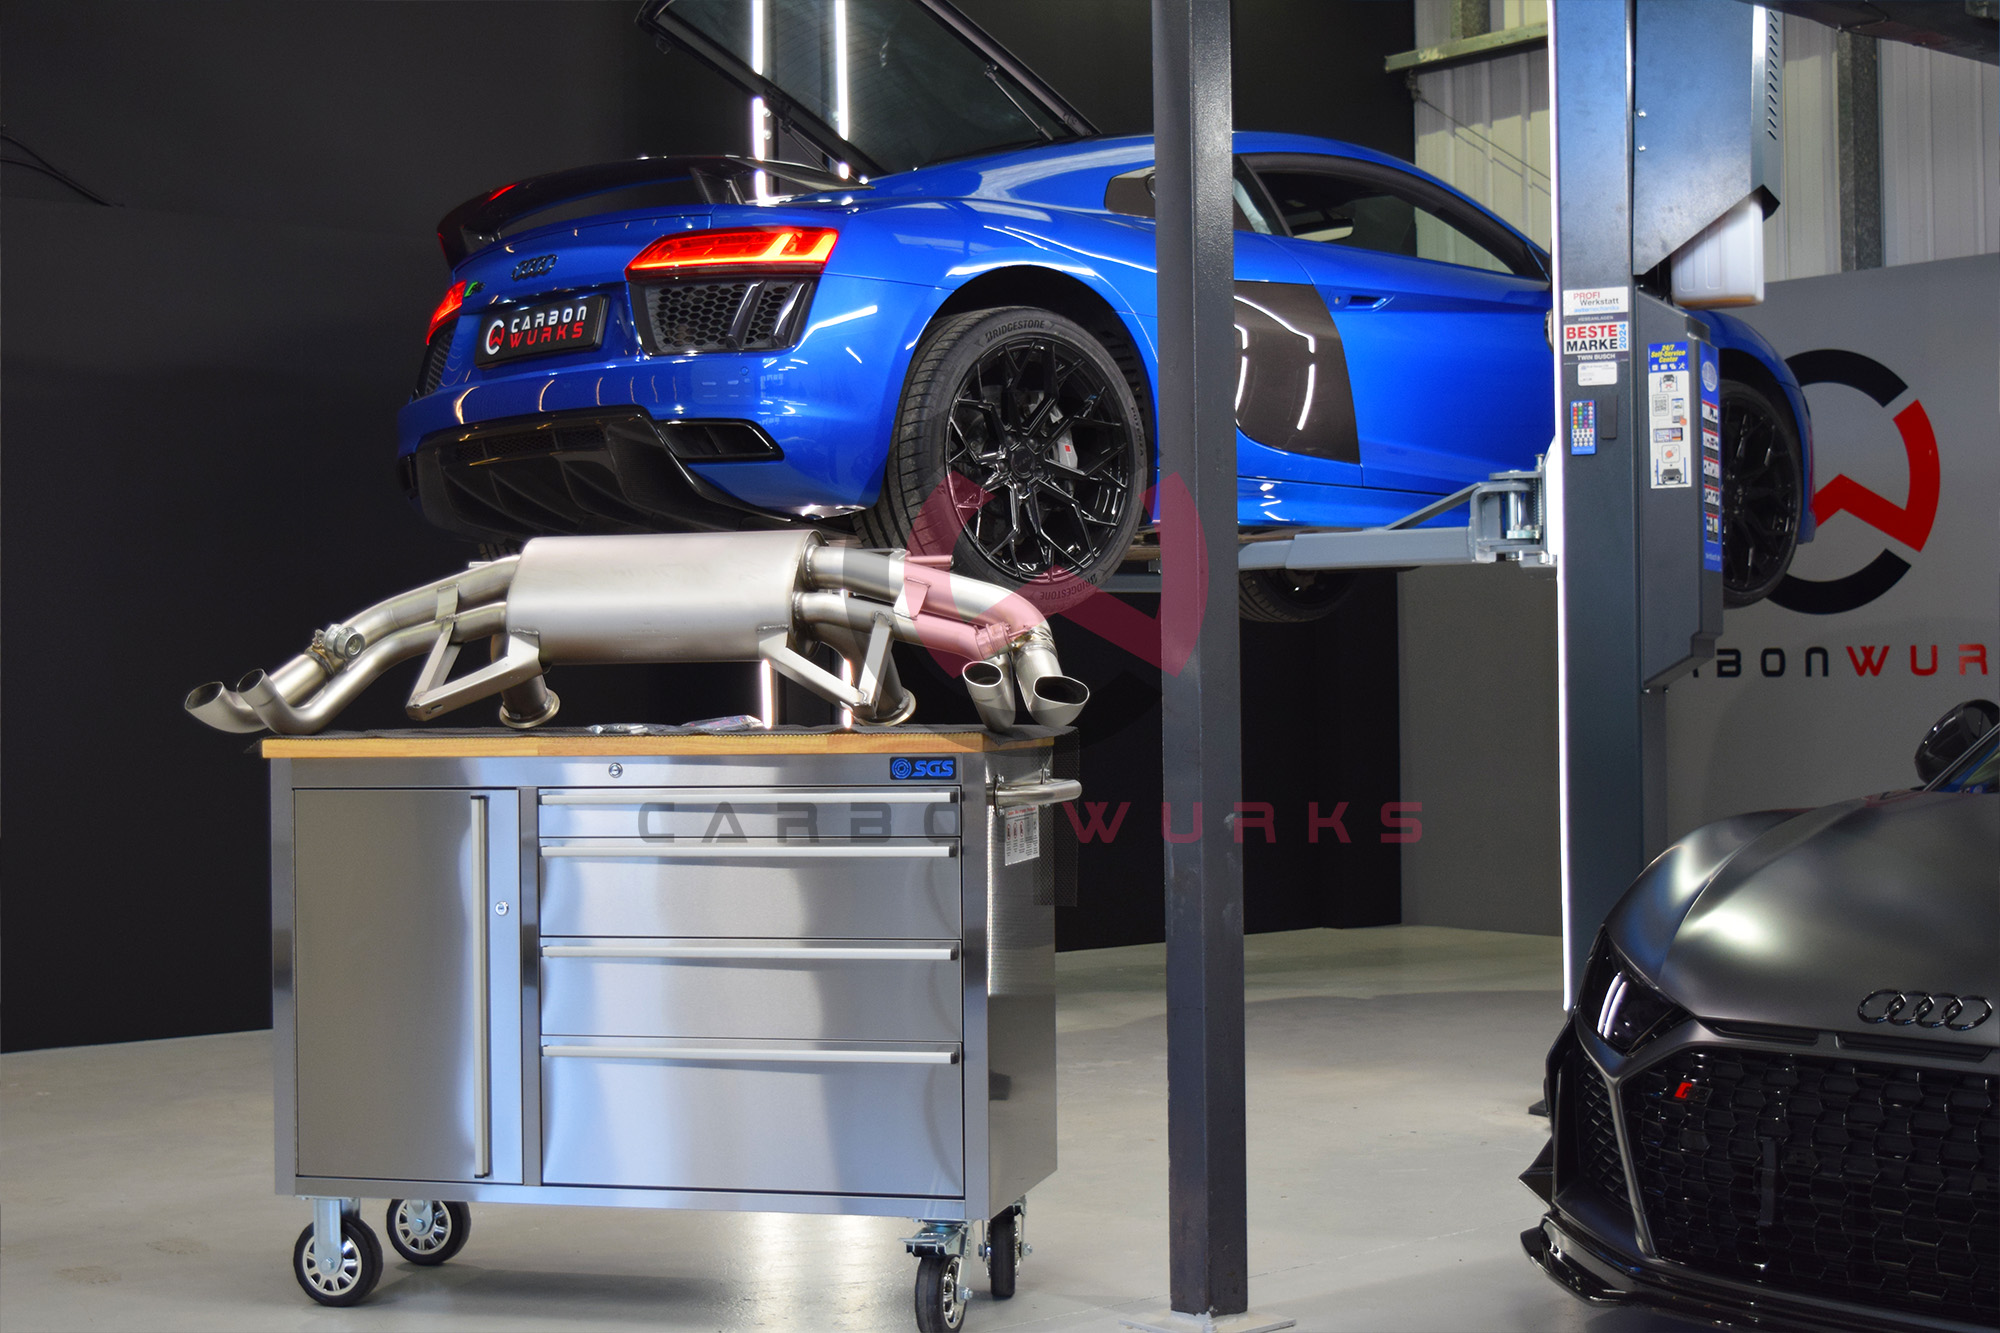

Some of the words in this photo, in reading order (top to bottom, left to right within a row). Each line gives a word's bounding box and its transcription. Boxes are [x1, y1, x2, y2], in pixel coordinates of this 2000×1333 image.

[1574, 292, 1600, 300] PROFI
[1579, 298, 1619, 306] Werkstatt
[511, 306, 587, 334] CARBON
[510, 321, 584, 349] WURKS
[984, 319, 1045, 343] BRIDGESTONE
[1566, 324, 1618, 340] BESTE
[1619, 323, 1627, 349] 2024
[1566, 338, 1618, 353] MARKE
[1651, 350, 1686, 358] Self-Service
[1594, 353, 1616, 361] BUSCH
[1040, 573, 1098, 601] BRIDGESTONE
[1692, 646, 1829, 678] BON
[911, 760, 954, 777] SGS
